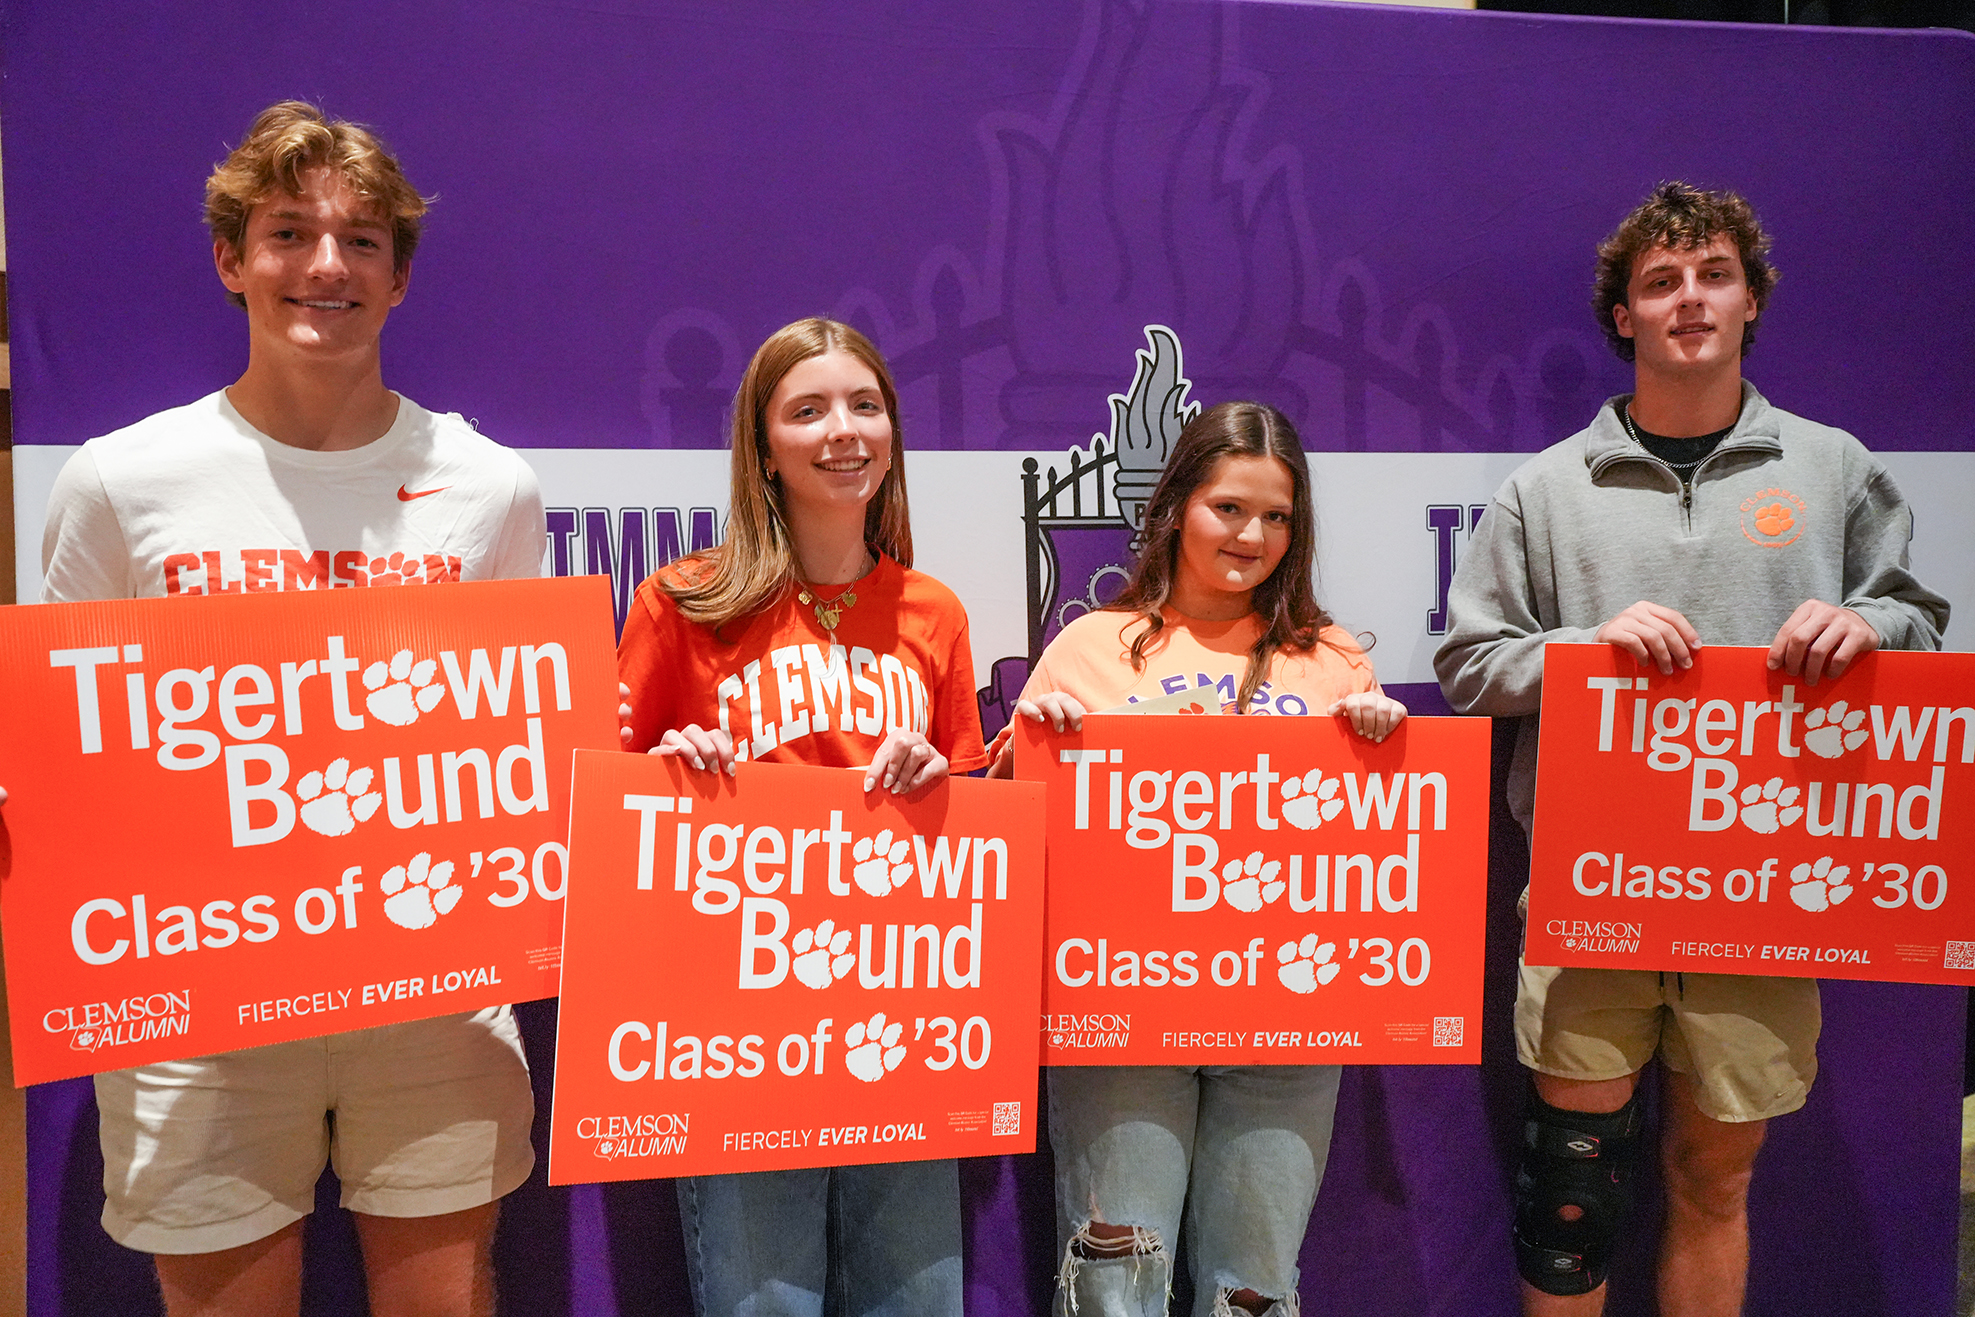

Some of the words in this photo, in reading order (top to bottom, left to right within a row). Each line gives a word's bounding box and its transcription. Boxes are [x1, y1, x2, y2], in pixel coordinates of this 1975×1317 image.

[1739, 487, 1808, 512] CLEMSON
[1573, 852, 1711, 900] Class
[1724, 858, 1778, 902] of
[1862, 863, 1947, 910] '30
[71, 894, 279, 965] Class
[294, 866, 363, 934] of
[470, 840, 568, 908] '30
[1546, 920, 1642, 939] CLEMSON
[1577, 937, 1640, 954] ALUMNI
[1672, 942, 1754, 957] FIERCELY
[1761, 946, 1809, 960] EVER
[1815, 948, 1870, 963] LOYAL
[1056, 938, 1199, 987] Class
[1211, 938, 1264, 986] of
[1348, 938, 1430, 986] '30
[239, 988, 352, 1025] FIERCELY
[362, 978, 424, 1005] EVER
[432, 966, 501, 994] LOYAL
[43, 990, 191, 1034] CLEMSON
[97, 1017, 190, 1049] ALUMNI
[1065, 1033, 1129, 1048] ALUMNI
[1163, 1032, 1246, 1047] FIERCELY
[1253, 1032, 1302, 1047] EVER
[1307, 1032, 1362, 1047] LOYAL
[608, 1021, 765, 1082] Class
[777, 1018, 833, 1076] of
[914, 1016, 991, 1071] '30
[576, 1113, 691, 1139] CLEMSON
[724, 1129, 812, 1151] FIERCELY
[818, 1126, 868, 1146] EVER
[873, 1123, 926, 1143] LOYAL
[614, 1136, 688, 1158] ALUMNI
